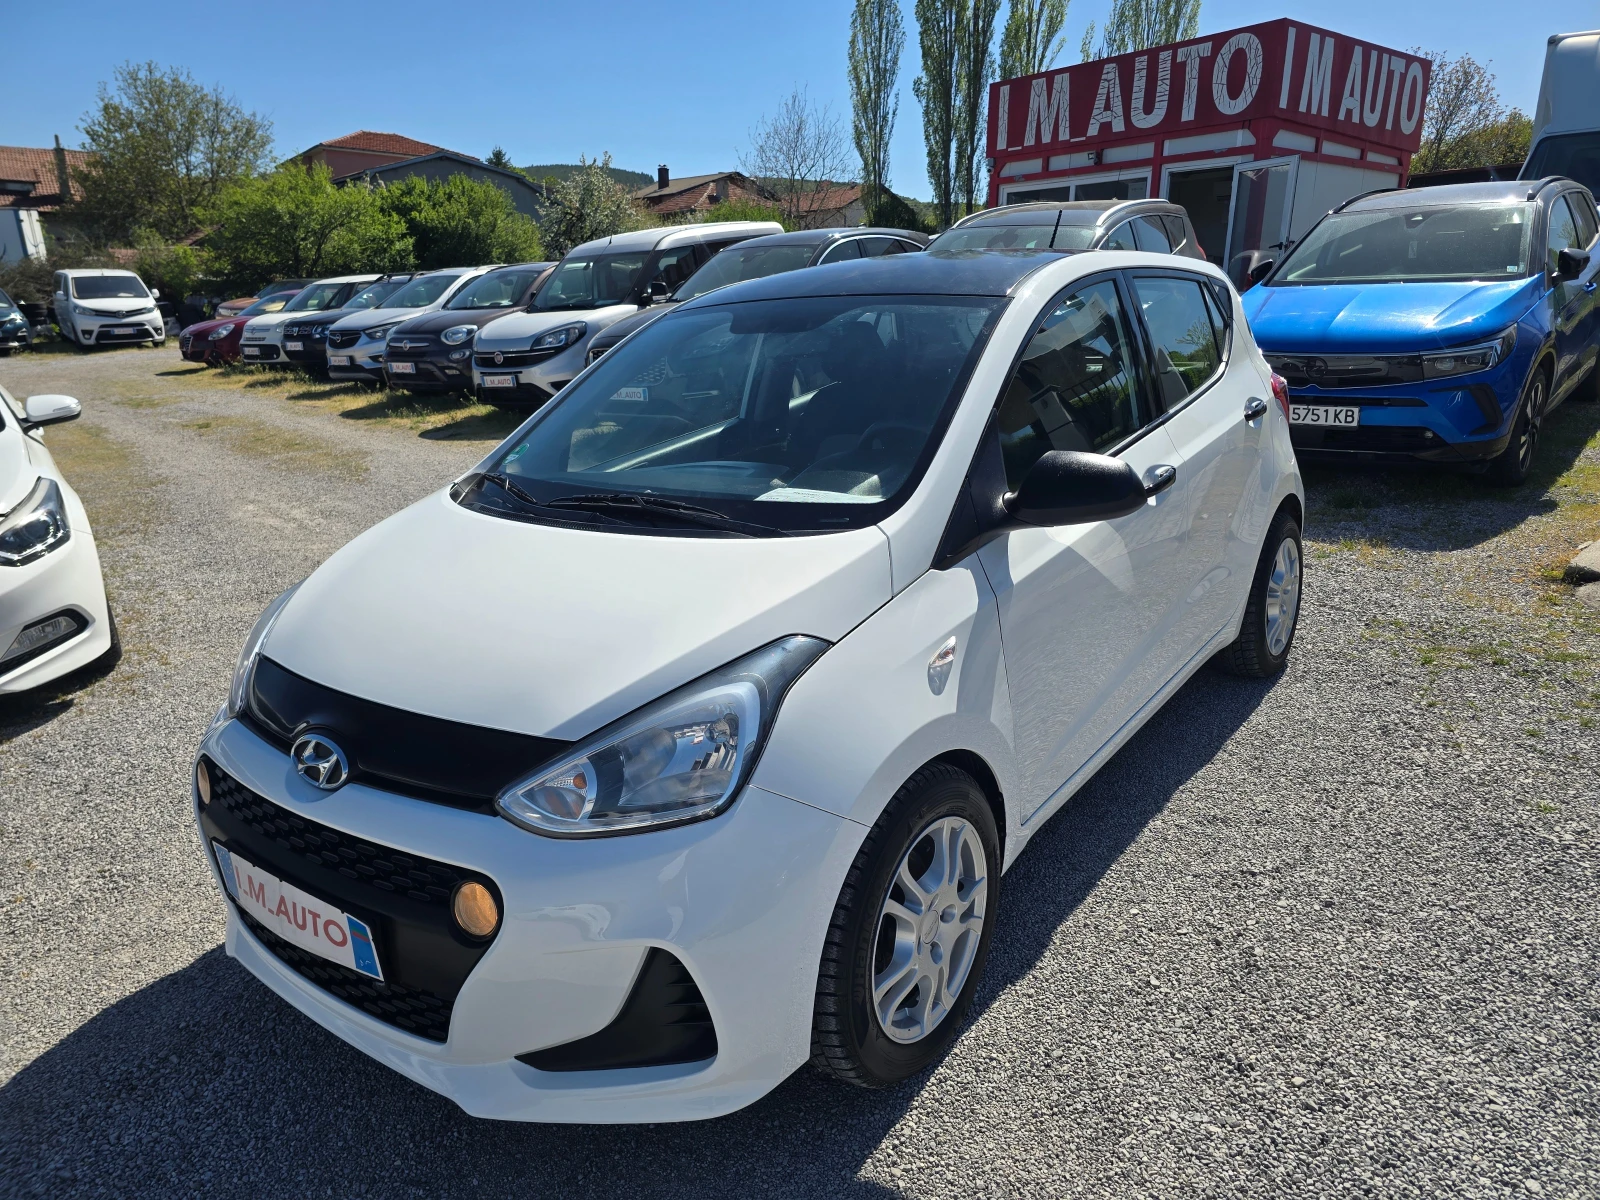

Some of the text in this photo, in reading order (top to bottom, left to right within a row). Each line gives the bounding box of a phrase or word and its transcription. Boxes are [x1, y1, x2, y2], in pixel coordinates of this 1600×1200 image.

[1279, 27, 1424, 135] I M AUTO
[854, 868, 888, 985] Hanko
